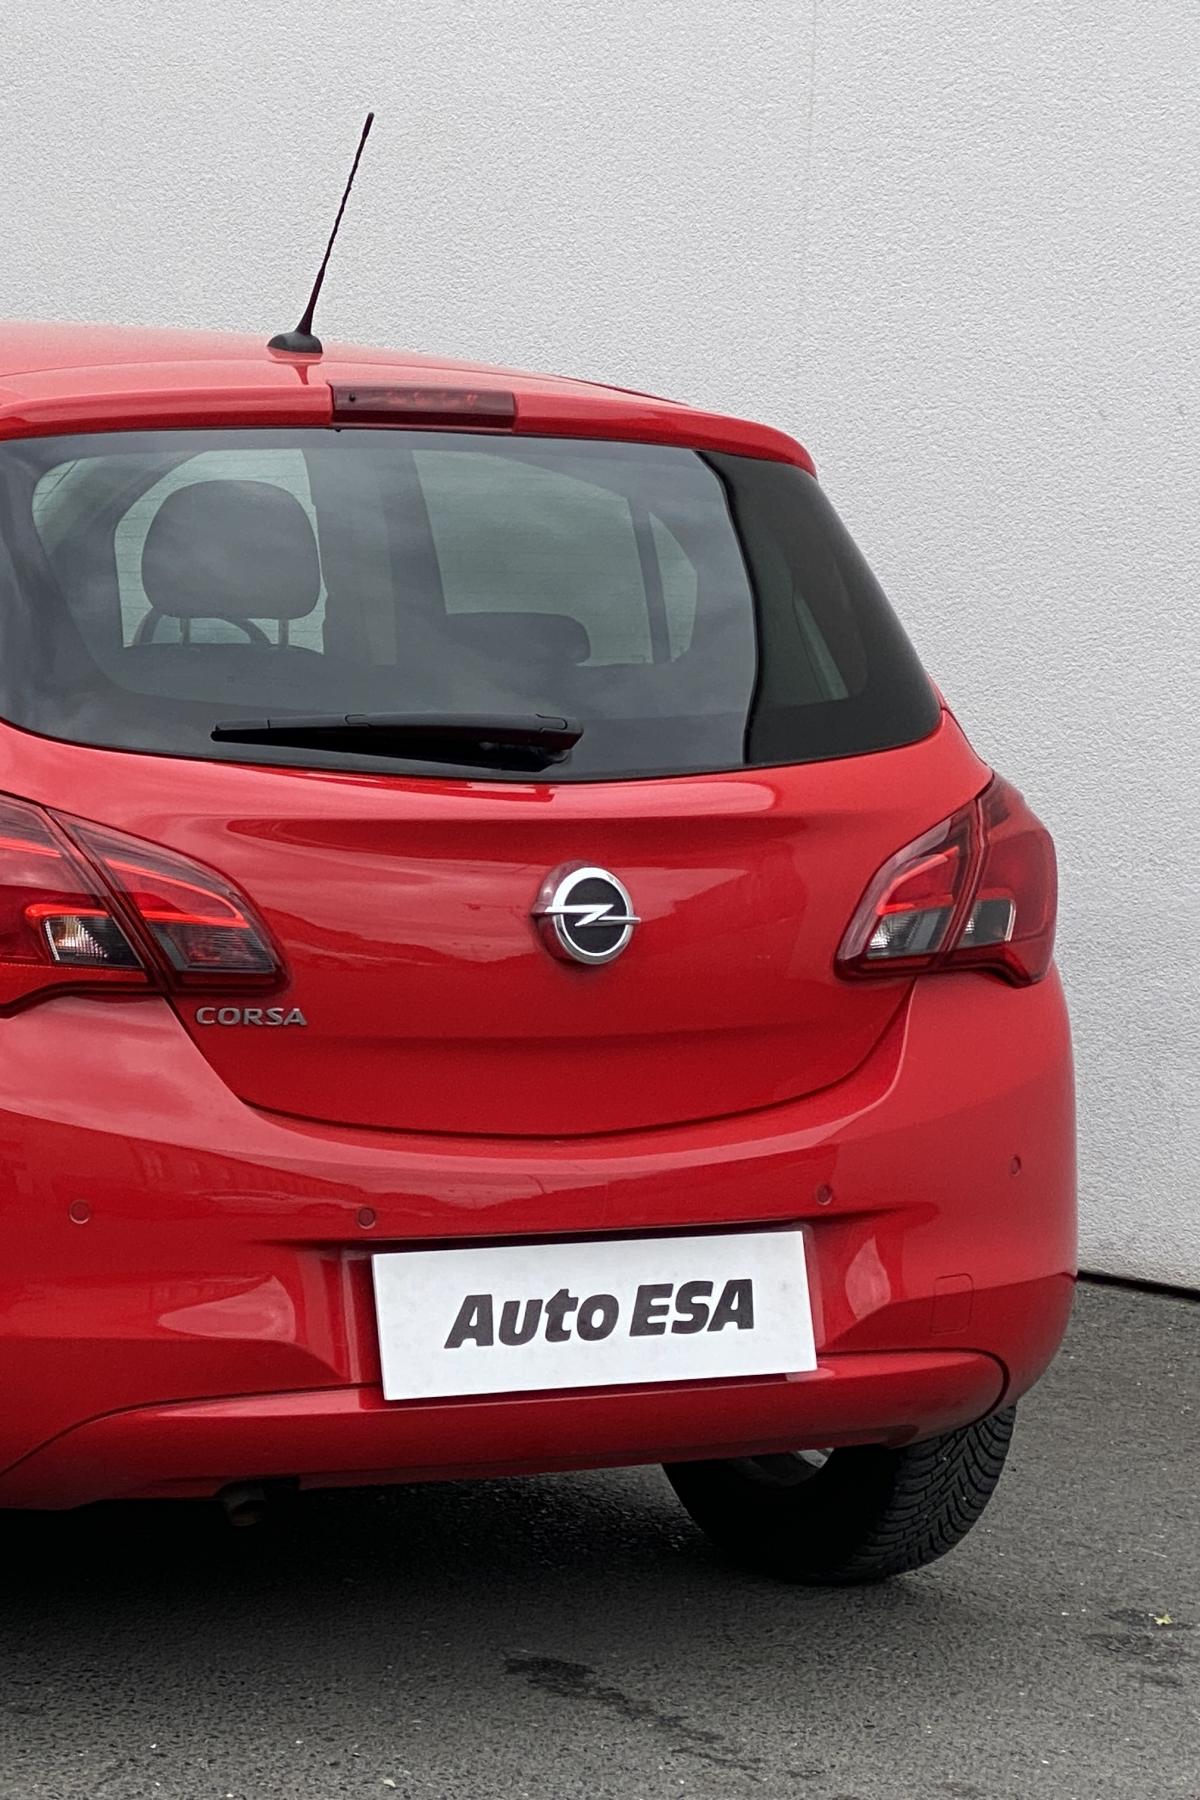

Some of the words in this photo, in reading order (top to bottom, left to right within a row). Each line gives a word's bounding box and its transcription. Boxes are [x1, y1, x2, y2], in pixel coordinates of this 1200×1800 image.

[196, 1007, 308, 1026] CORSA
[443, 1288, 620, 1349] Auto
[628, 1278, 755, 1337] ESA
